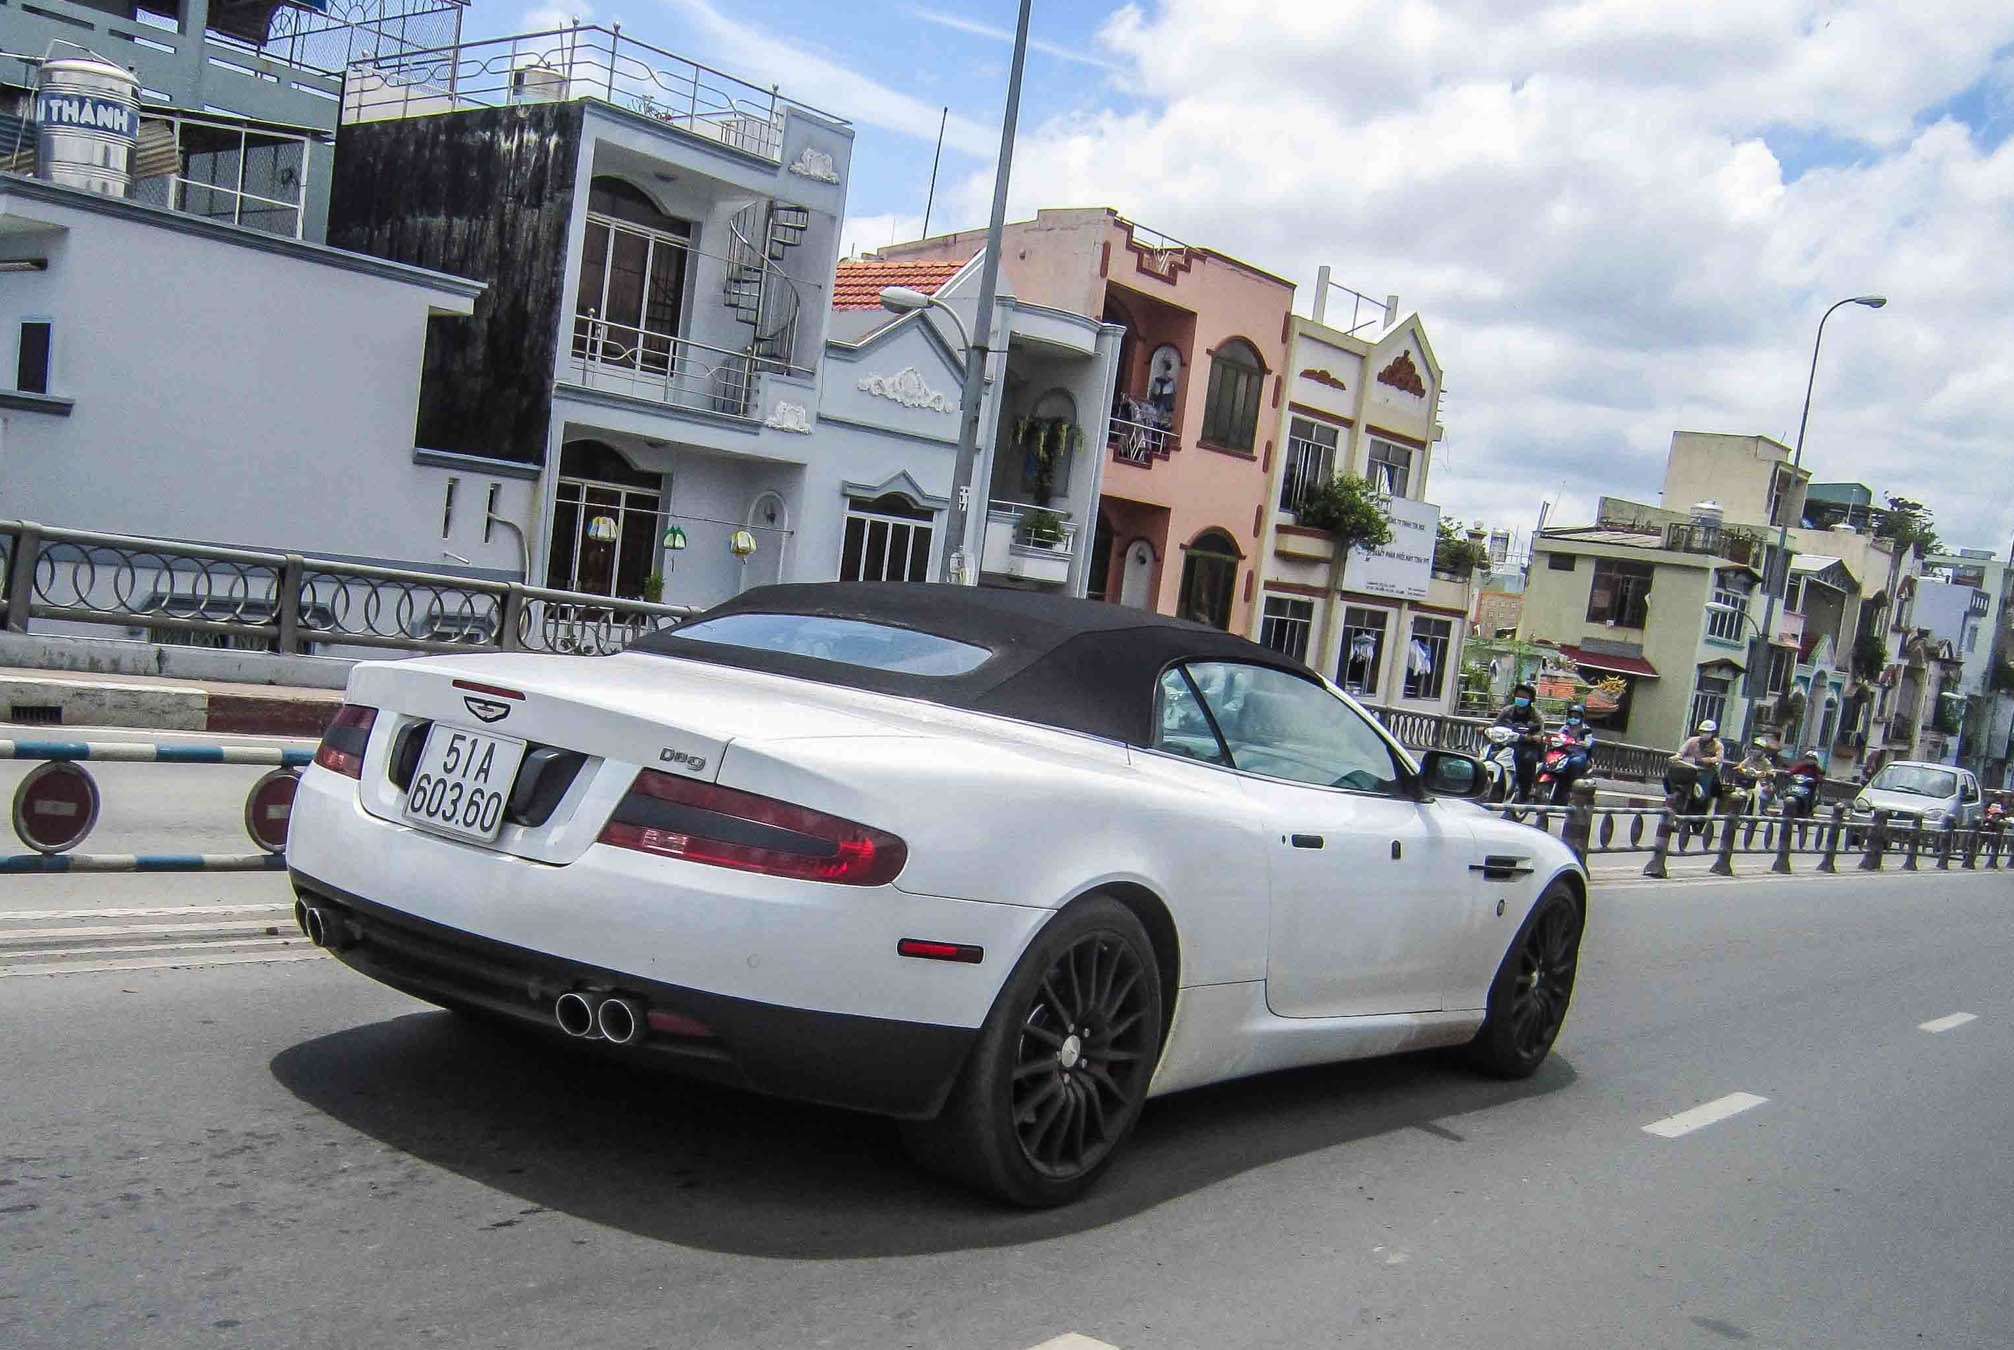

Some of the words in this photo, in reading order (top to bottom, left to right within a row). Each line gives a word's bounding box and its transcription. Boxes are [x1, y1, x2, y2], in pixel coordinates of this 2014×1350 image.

[49, 98, 128, 132] THÀNH
[443, 733, 496, 784] 51A
[410, 773, 502, 832] 603.60
